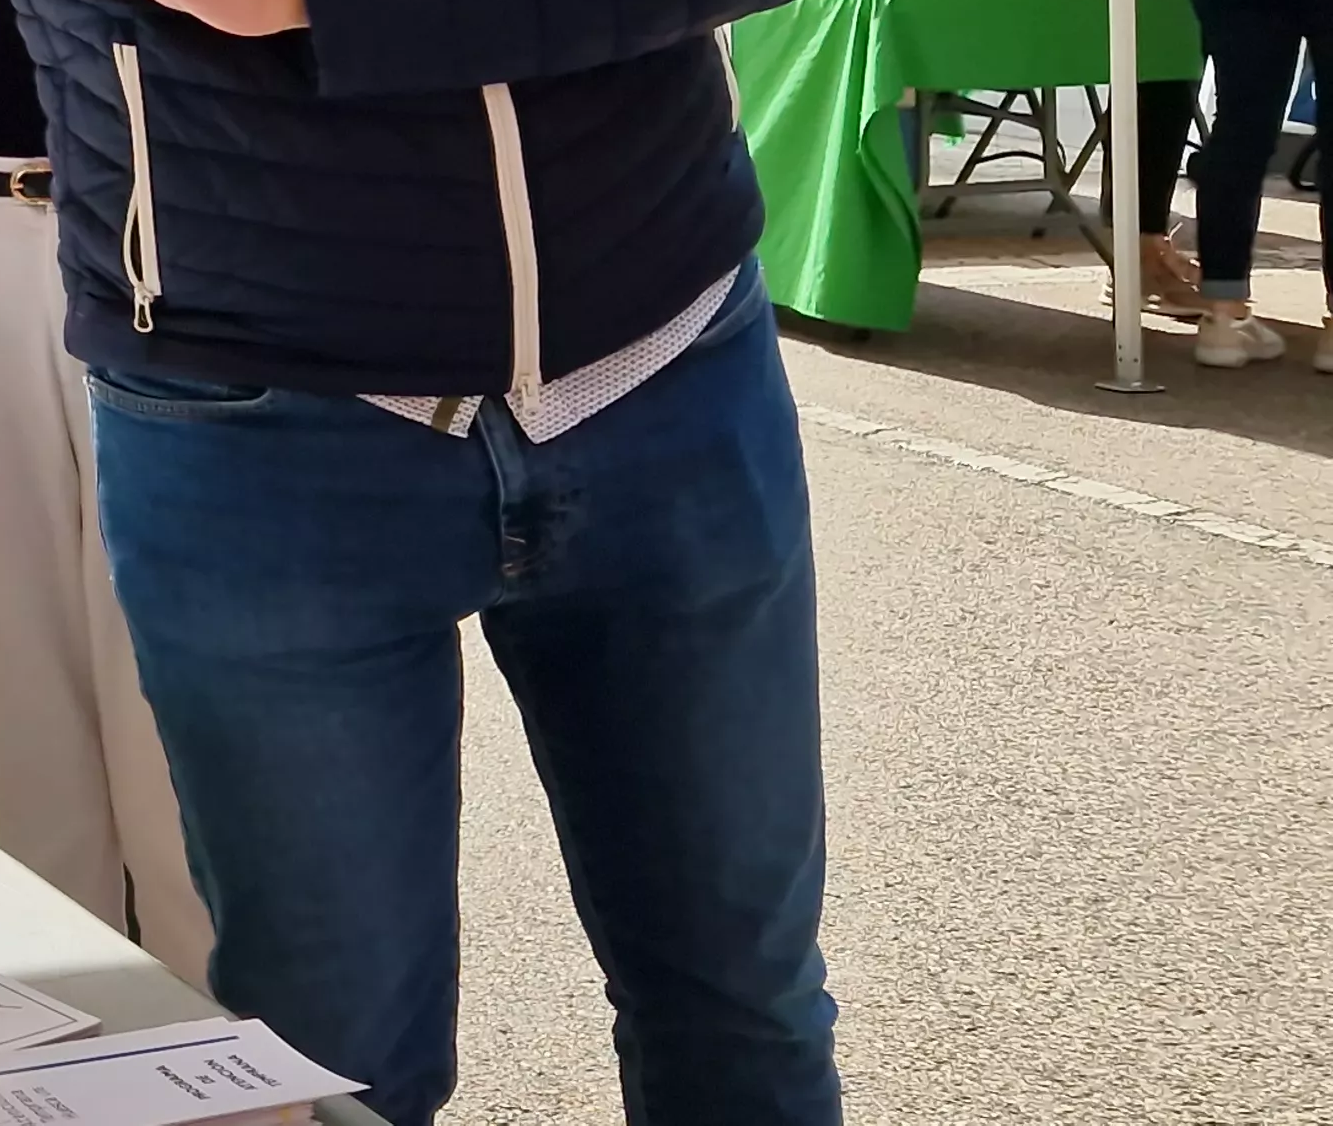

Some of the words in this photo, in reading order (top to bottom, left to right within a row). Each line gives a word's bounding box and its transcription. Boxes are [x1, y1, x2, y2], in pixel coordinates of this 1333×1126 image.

[152, 1064, 211, 1100] PROGRAMA
[192, 1073, 217, 1085] DE
[224, 1053, 282, 1087] TEMPRANA
